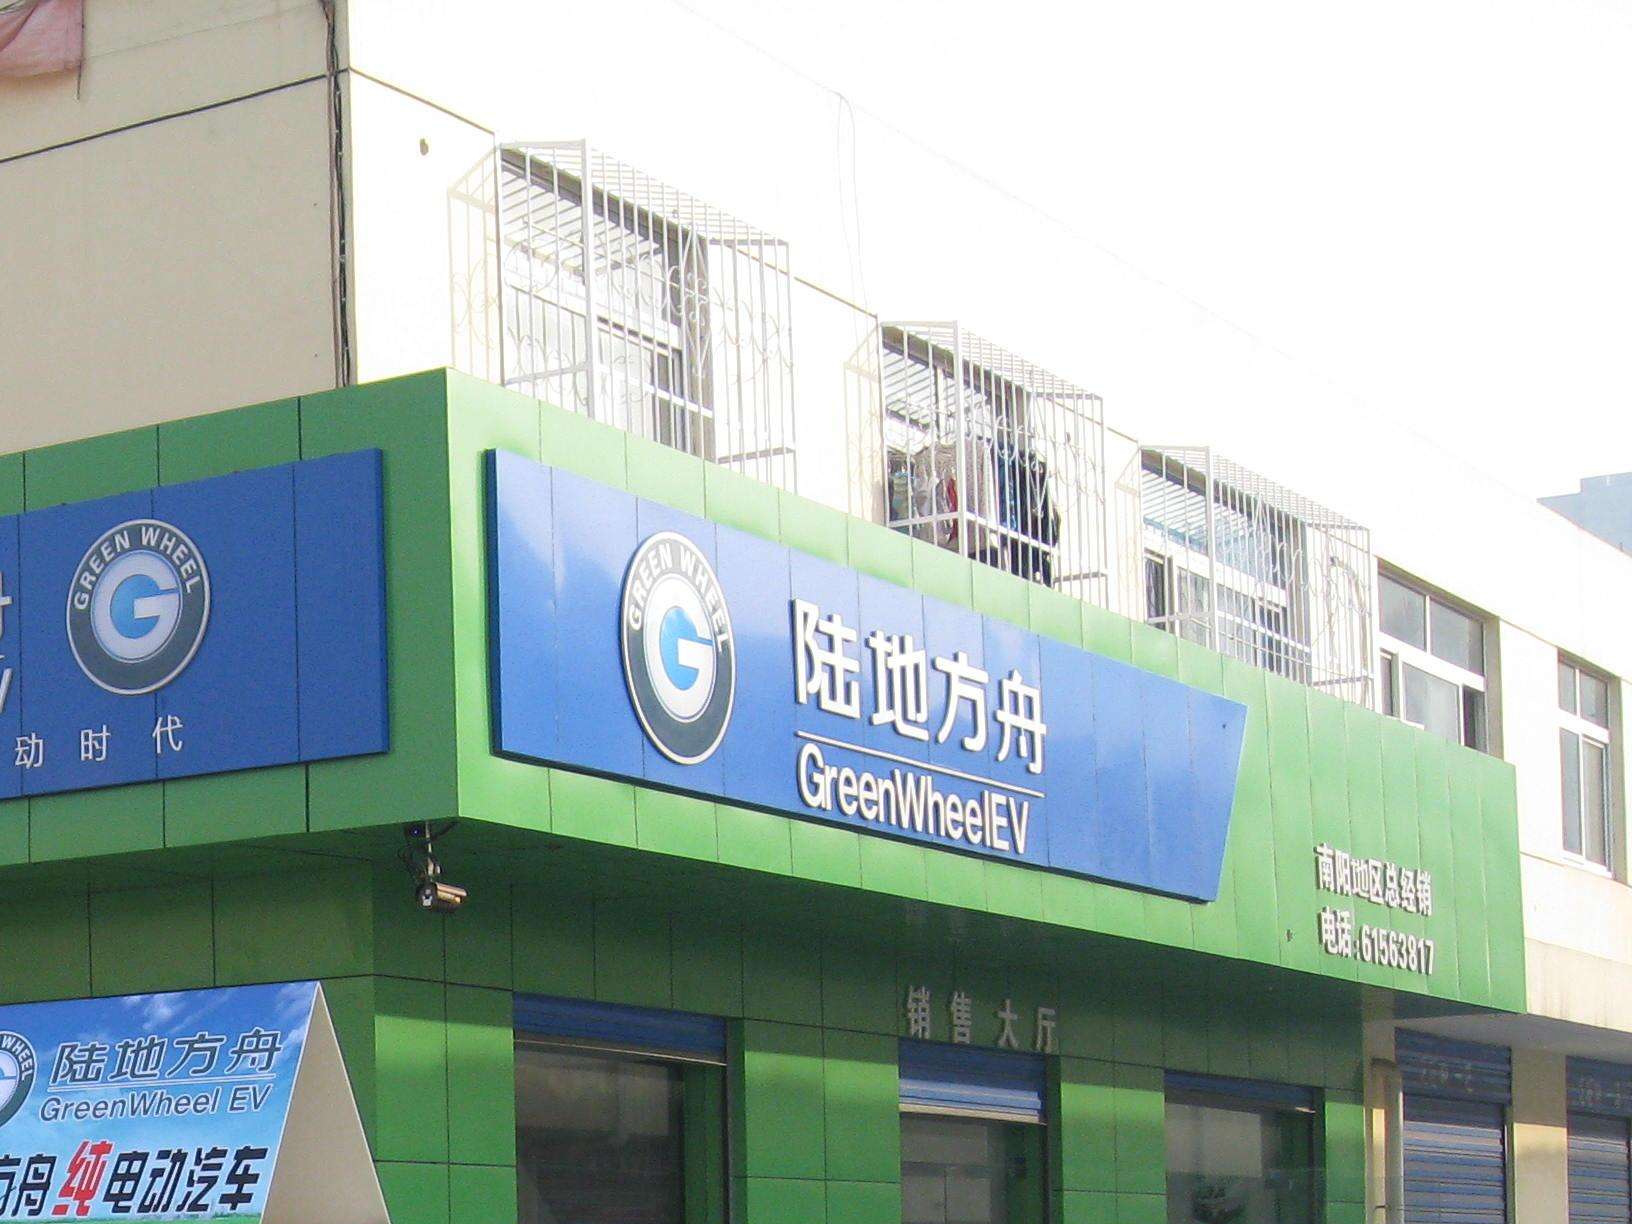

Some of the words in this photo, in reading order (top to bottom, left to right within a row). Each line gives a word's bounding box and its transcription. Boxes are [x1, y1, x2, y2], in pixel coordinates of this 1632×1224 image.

[74, 530, 131, 610] GREEN
[141, 526, 201, 593] WHEEL
[629, 542, 674, 631] GREEN
[680, 545, 731, 653] WHEEL
[792, 598, 1047, 775] 陆地方舟
[798, 742, 1029, 855] GreenWheelEV
[1314, 842, 1432, 917] 南阳地区总经销
[0, 1034, 34, 1082] WHEEL
[49, 1027, 283, 1086] 陆地方舟
[907, 985, 1057, 1056] 销售大厅
[39, 1092, 218, 1123] GreenWheel
[226, 1084, 273, 1114] EV
